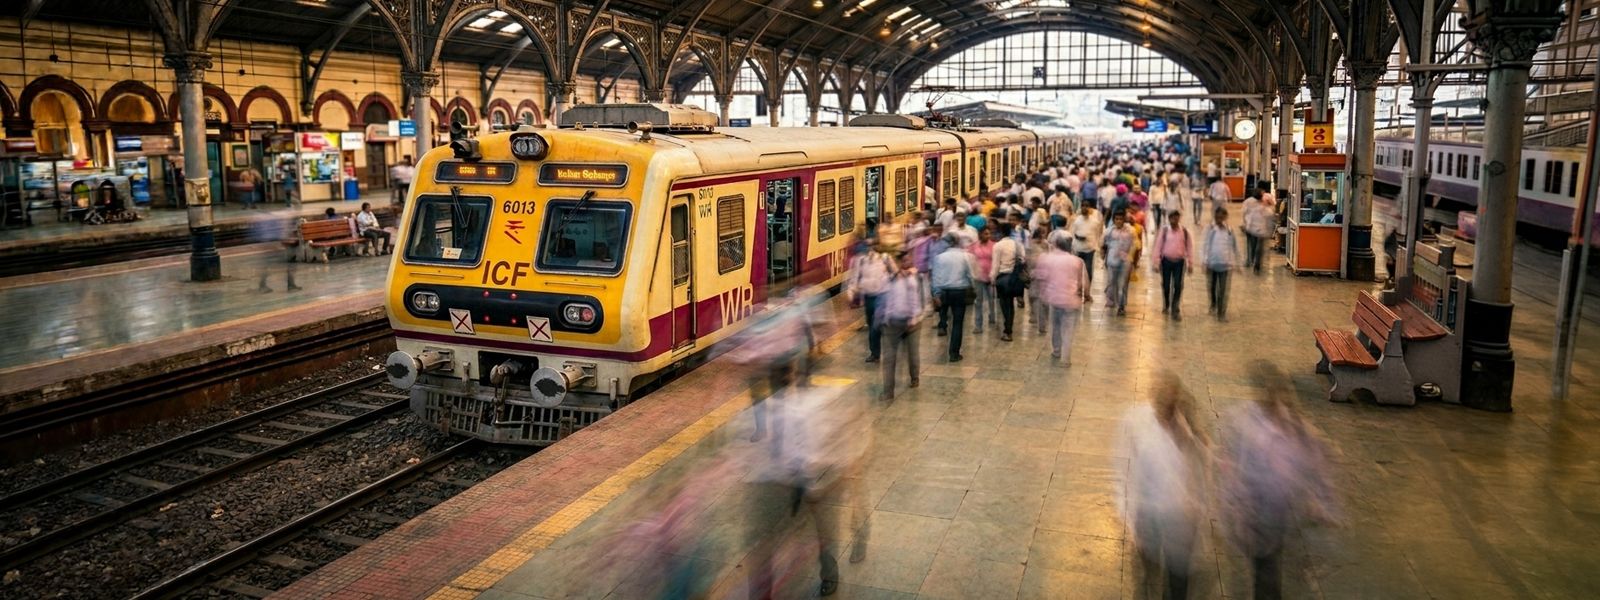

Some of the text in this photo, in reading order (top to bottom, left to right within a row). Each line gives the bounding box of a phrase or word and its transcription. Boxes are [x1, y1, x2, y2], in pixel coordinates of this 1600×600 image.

[503, 200, 536, 215] 6013
[481, 260, 531, 286] ICF
[719, 283, 754, 328] WR
